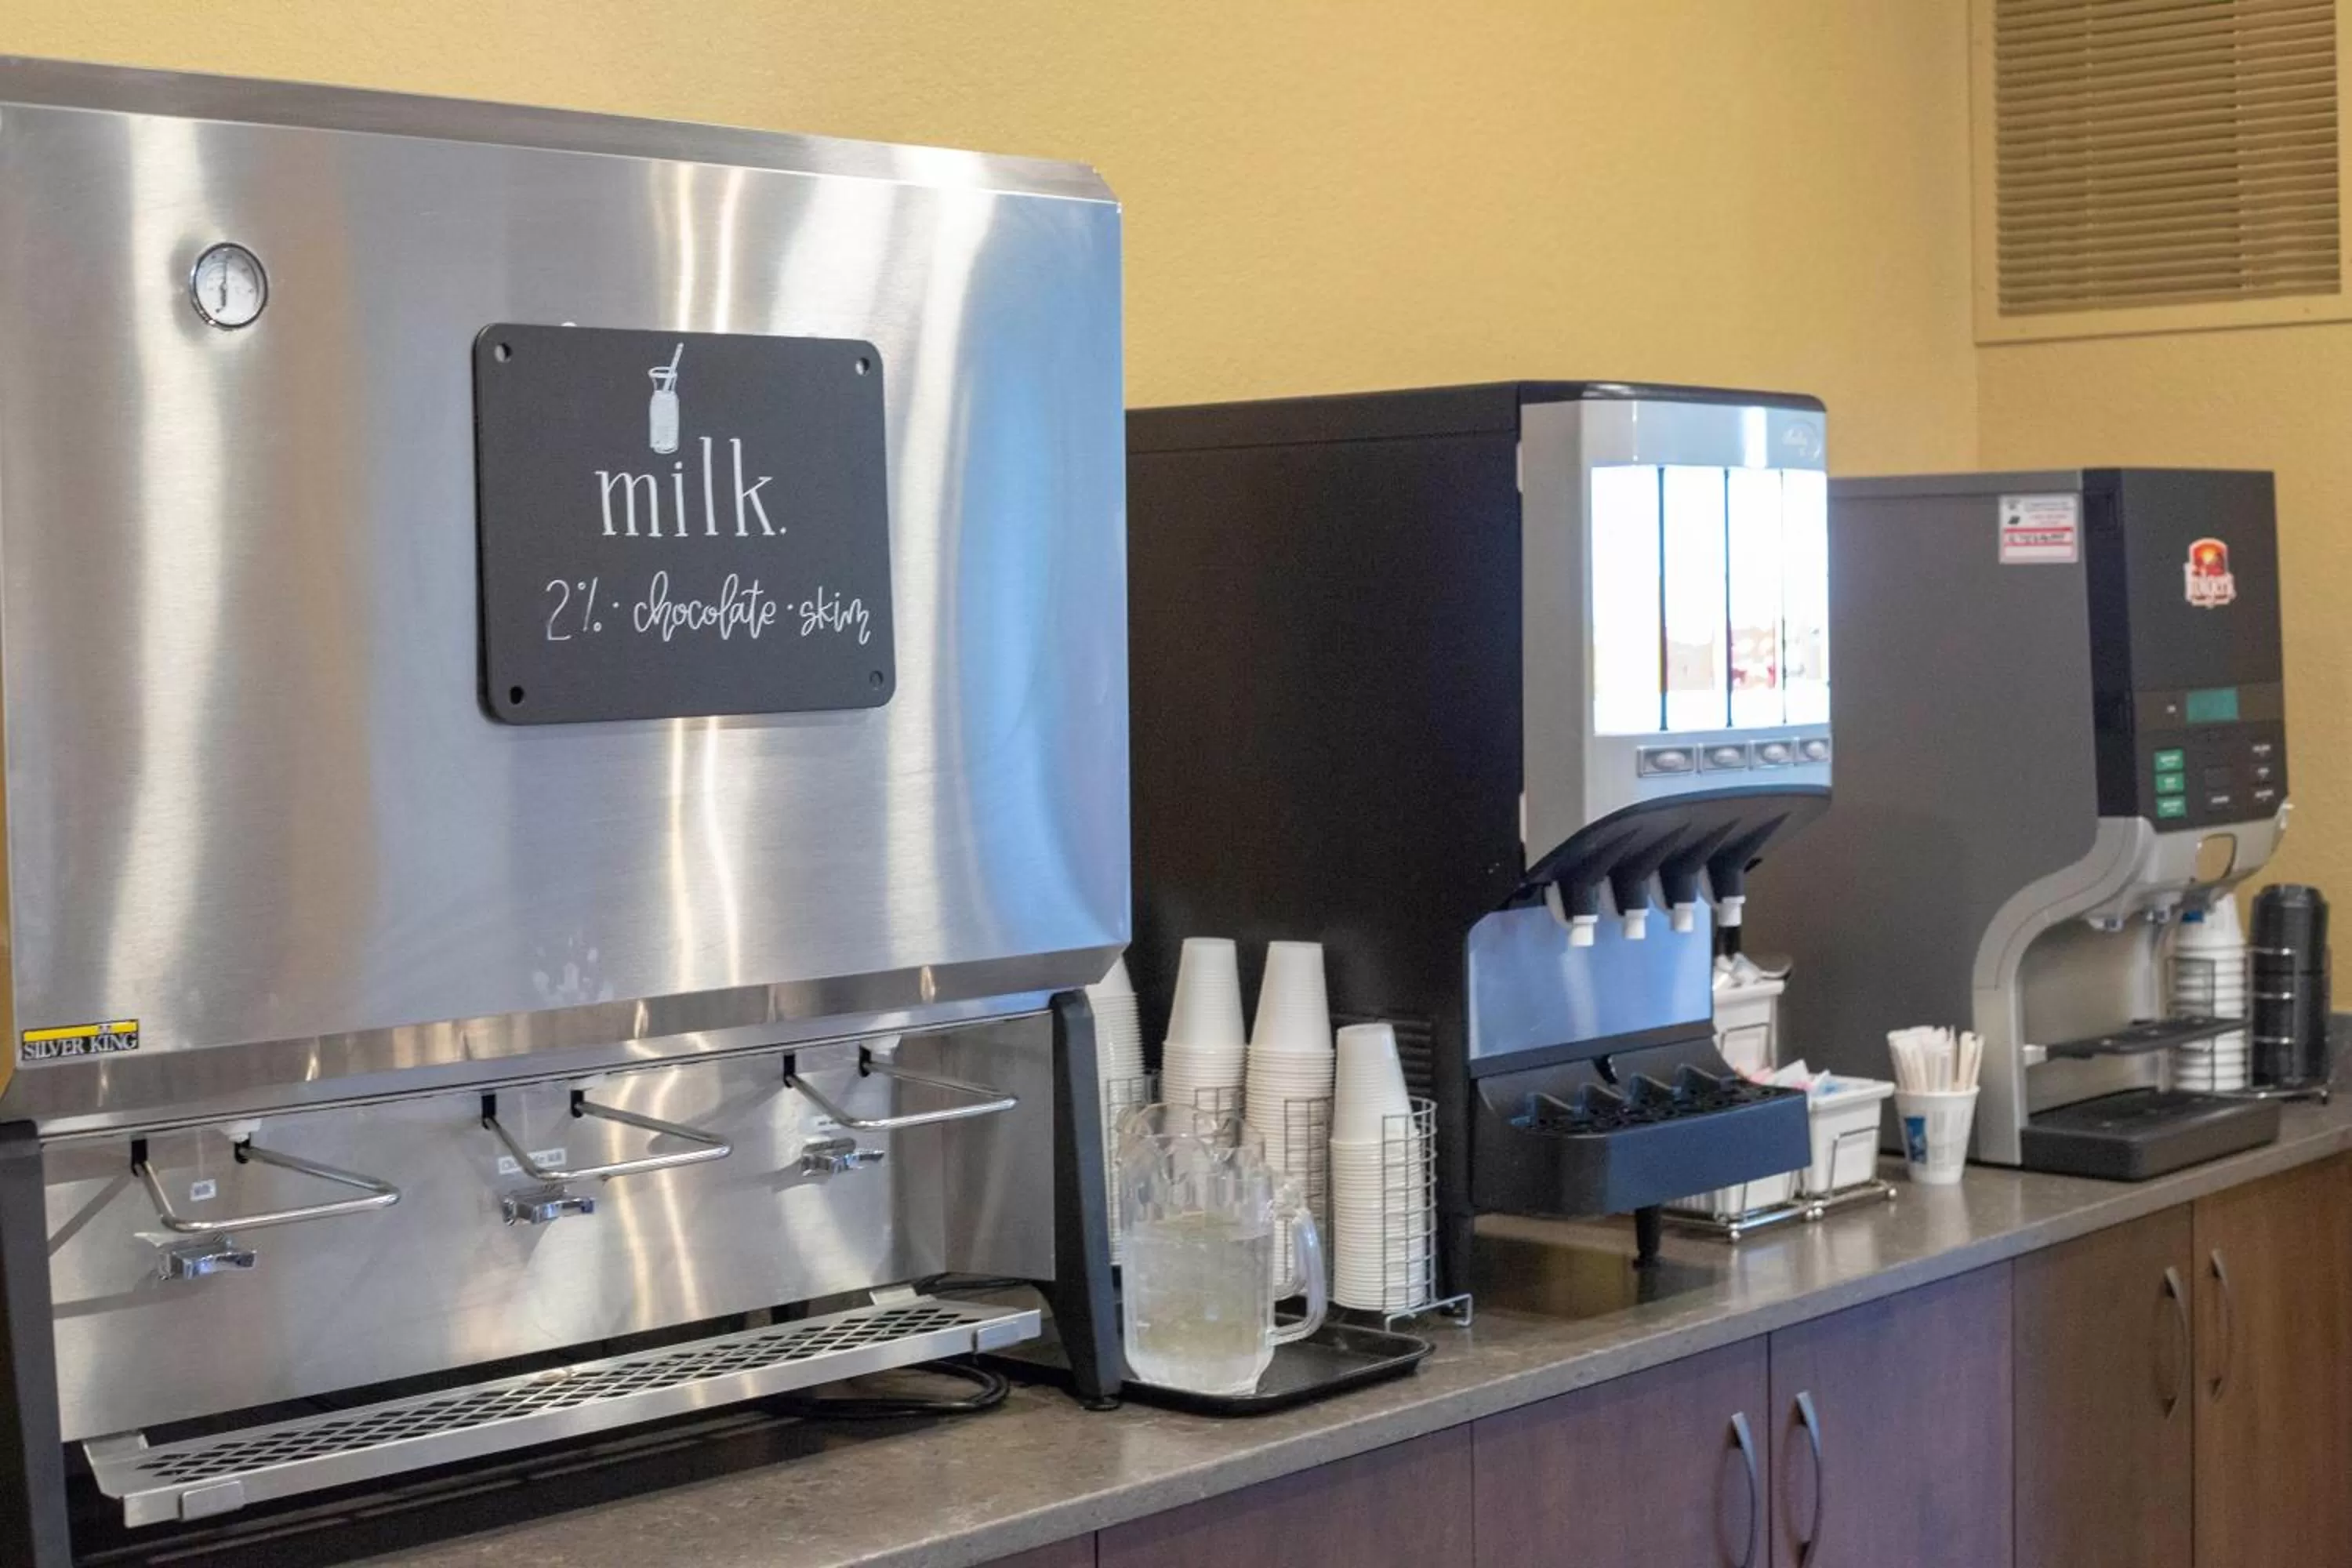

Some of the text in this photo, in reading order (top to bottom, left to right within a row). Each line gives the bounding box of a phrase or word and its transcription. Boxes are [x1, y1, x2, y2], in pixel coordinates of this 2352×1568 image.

[546, 570, 872, 646] 2% chocolate skim
[24, 1033, 137, 1059] SILVER KING
